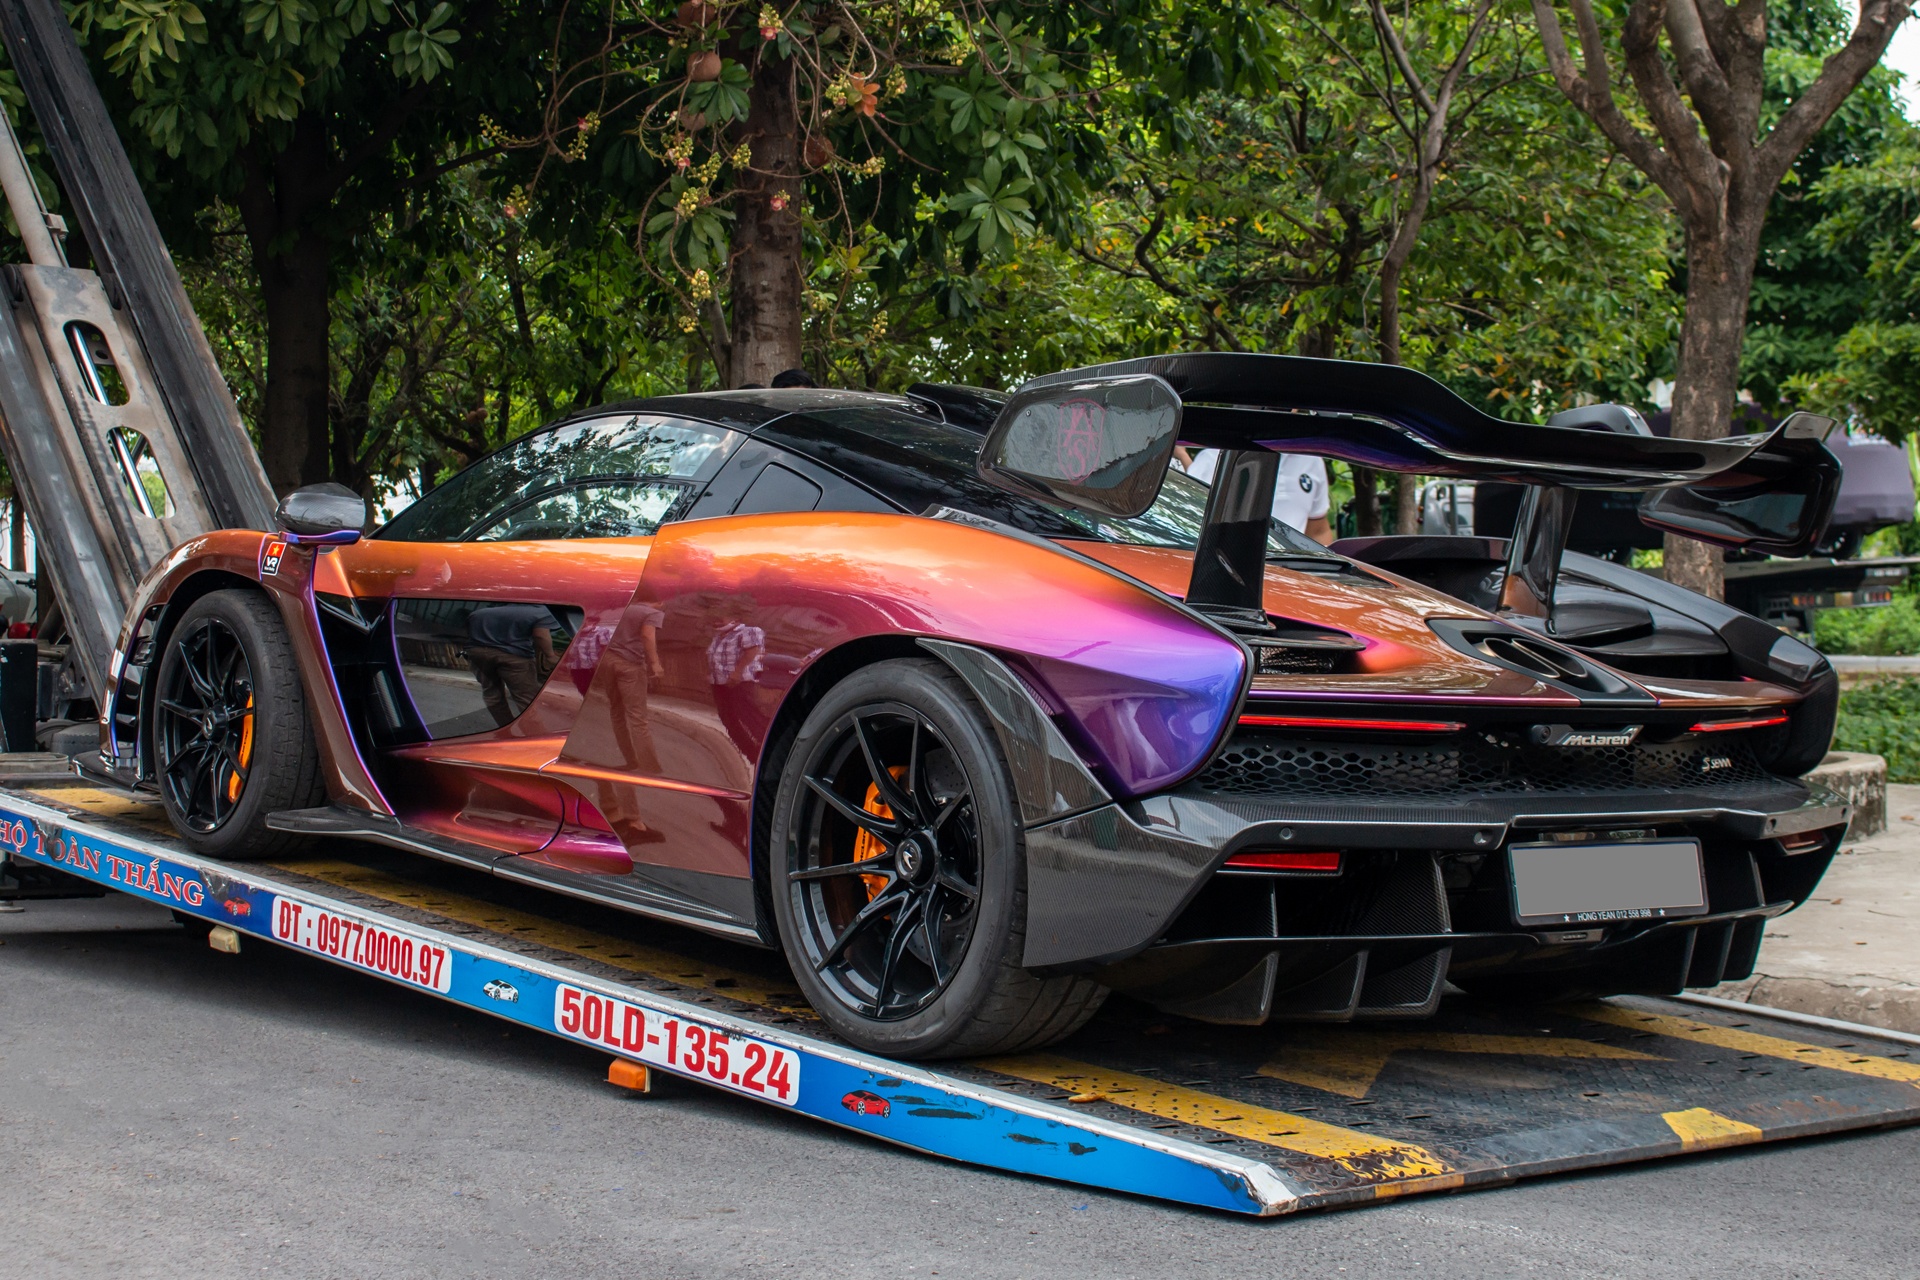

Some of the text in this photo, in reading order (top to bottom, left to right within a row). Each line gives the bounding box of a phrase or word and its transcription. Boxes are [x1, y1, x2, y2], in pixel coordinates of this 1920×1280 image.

[1562, 734, 1631, 746] McLaren
[32, 831, 101, 874] TOÀN
[106, 855, 205, 907] THẮNG
[317, 912, 446, 990] 0977.0000.97
[1577, 911, 1598, 921] HONG
[1598, 910, 1616, 920] YEAN
[1616, 910, 1628, 919] 012
[561, 987, 791, 1100] 50LD-135.24
